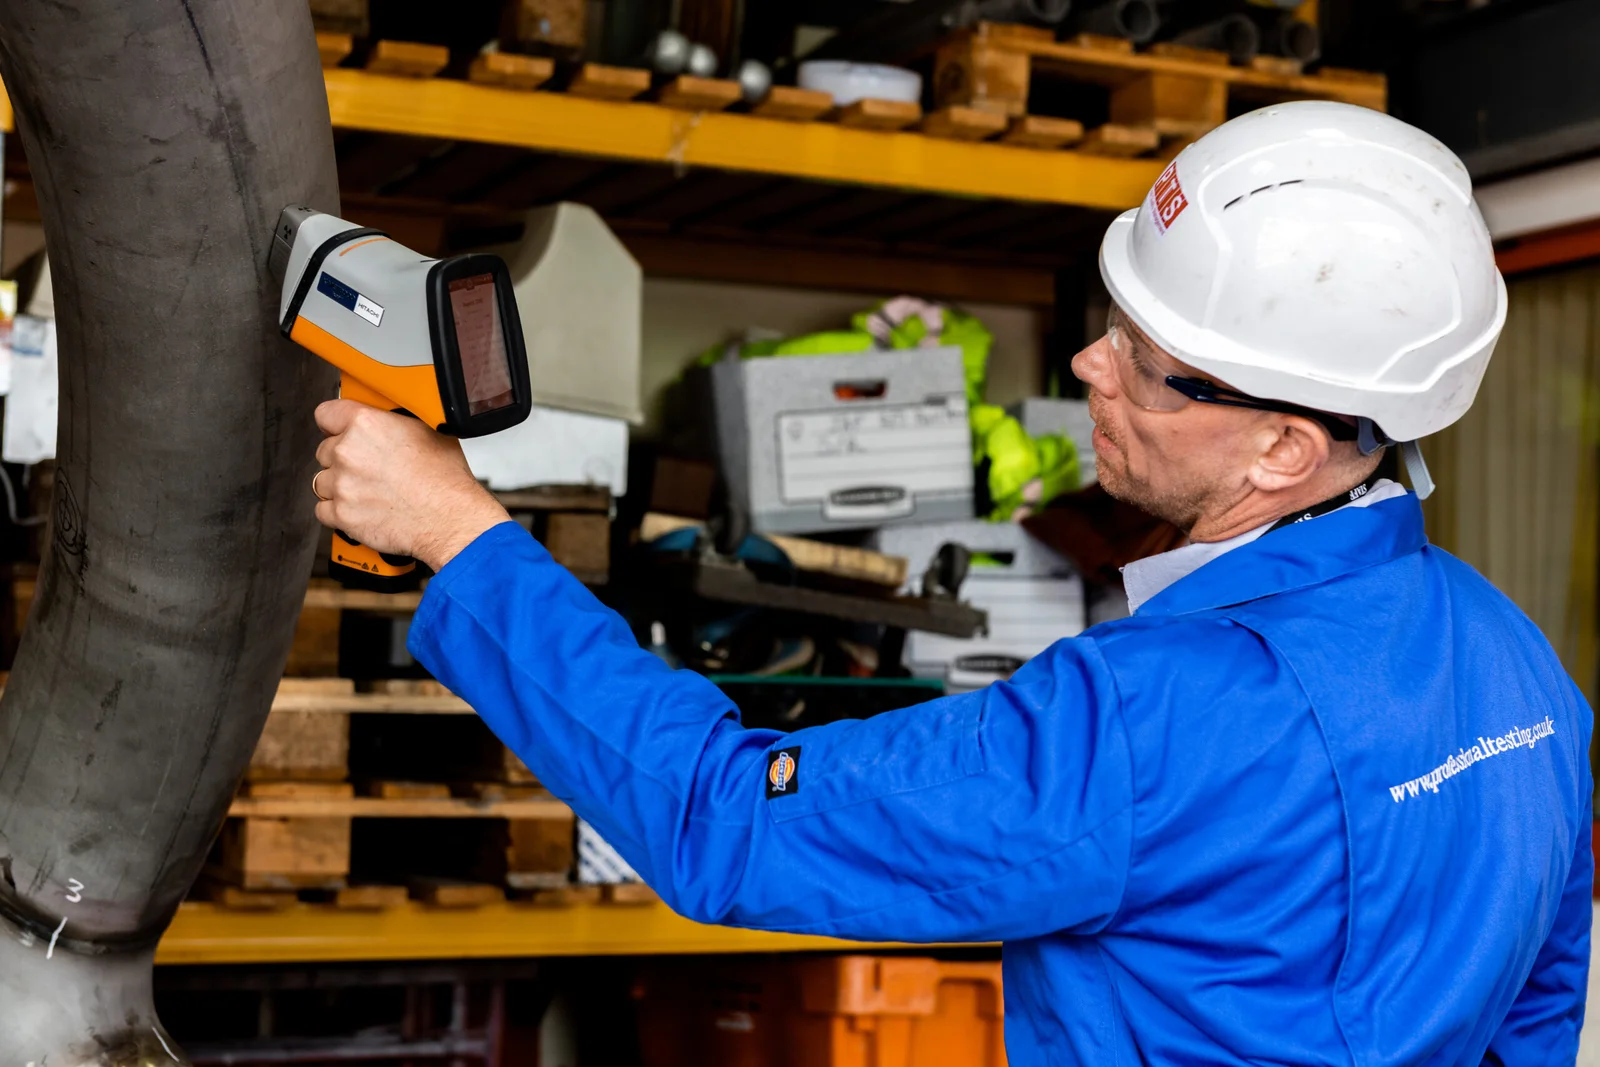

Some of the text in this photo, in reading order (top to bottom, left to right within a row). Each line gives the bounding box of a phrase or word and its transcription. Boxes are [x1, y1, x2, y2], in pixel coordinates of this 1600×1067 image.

[1156, 166, 1183, 221] PTS
[357, 302, 380, 318] HITACHI
[1349, 484, 1368, 500] STAFF
[65, 878, 85, 903] 3
